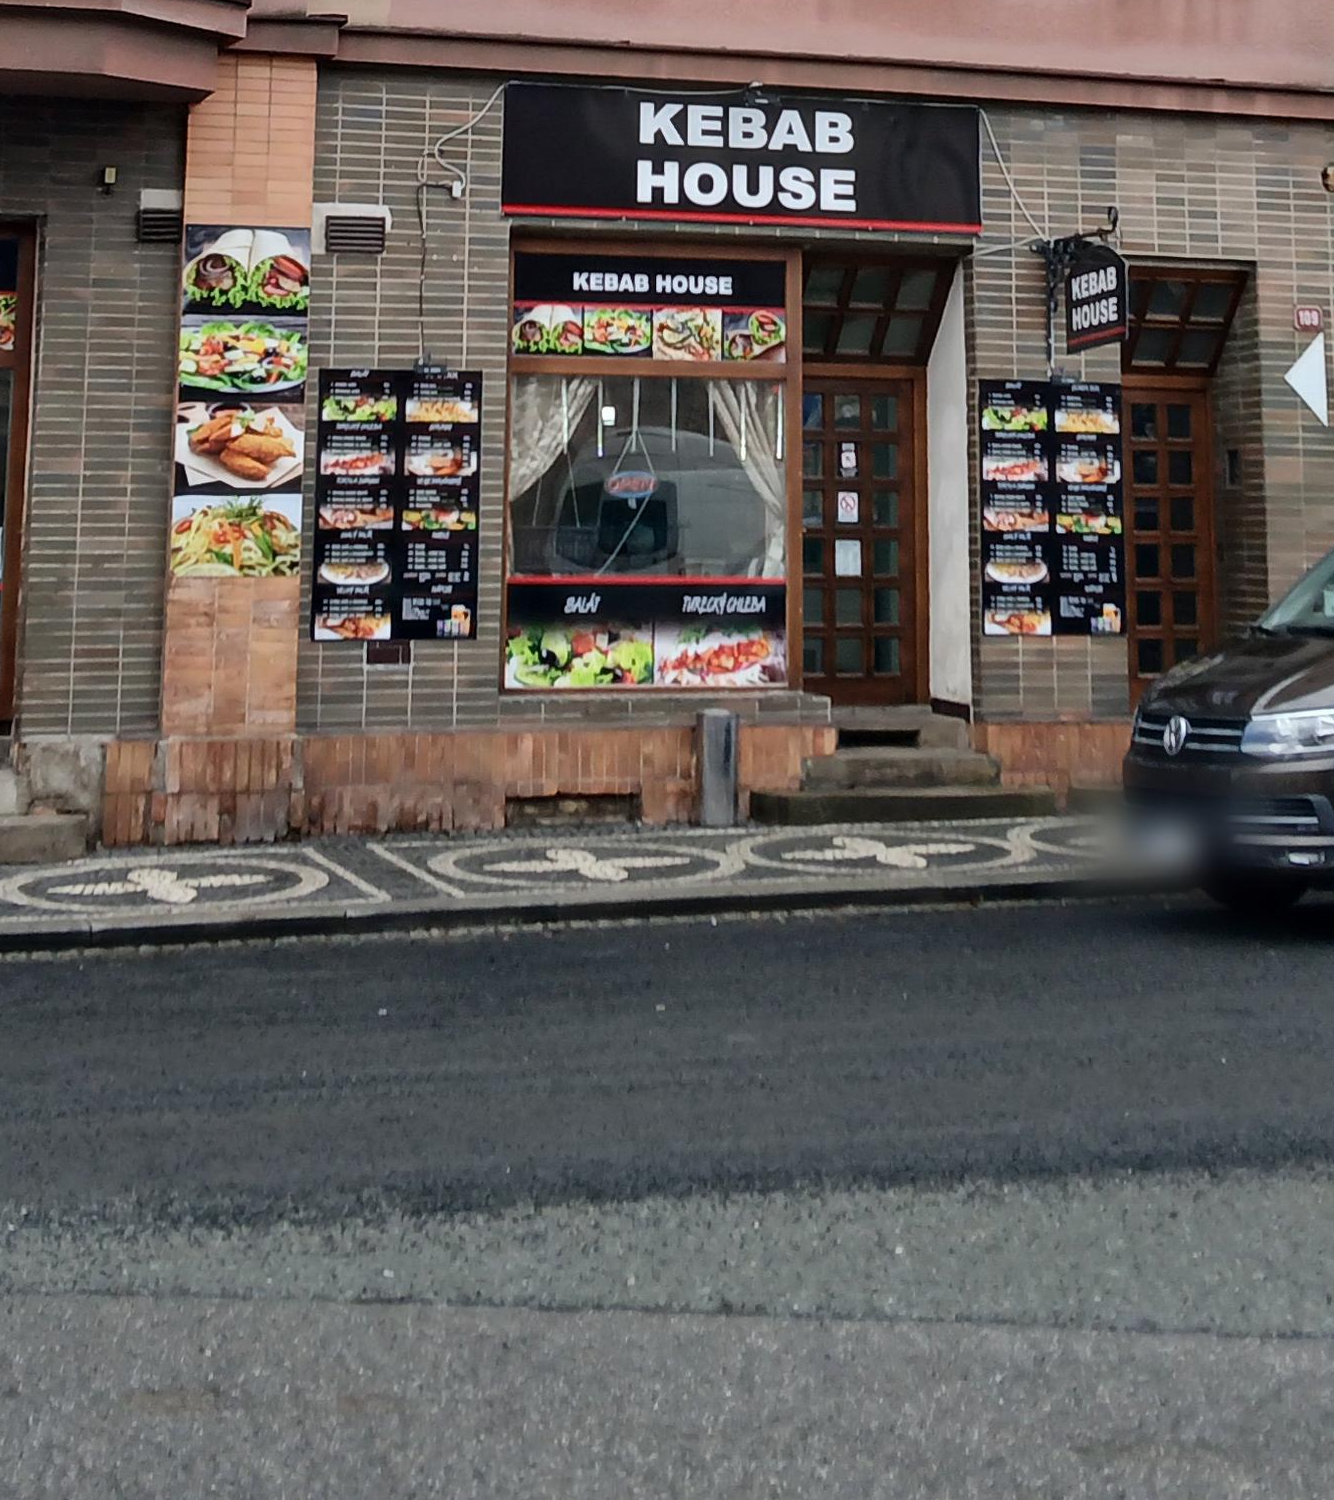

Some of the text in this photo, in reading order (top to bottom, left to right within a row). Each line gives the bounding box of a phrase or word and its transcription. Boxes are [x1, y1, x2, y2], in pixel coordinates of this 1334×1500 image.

[639, 102, 855, 154] KEBAB
[636, 159, 857, 213] HOUSE
[573, 272, 733, 295] KEBAB HOUSE
[1071, 266, 1117, 301] KEBAB
[1072, 296, 1118, 331] HOUSE
